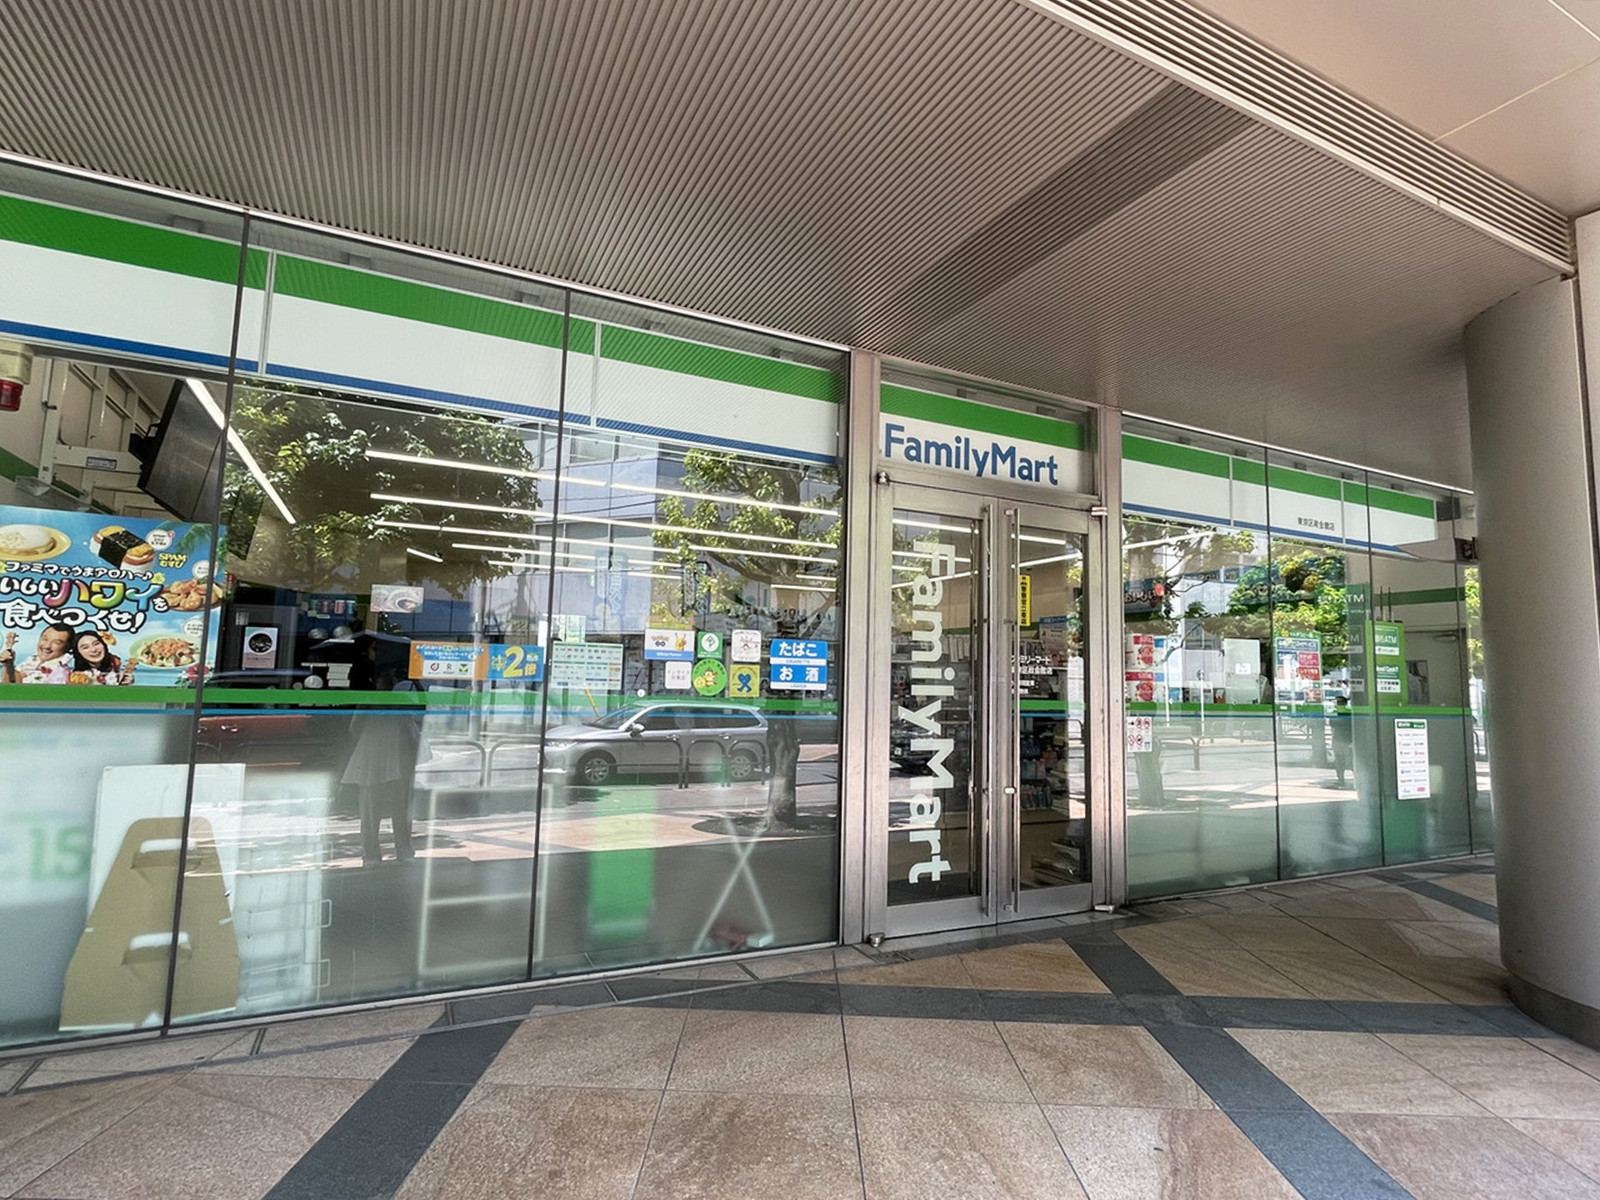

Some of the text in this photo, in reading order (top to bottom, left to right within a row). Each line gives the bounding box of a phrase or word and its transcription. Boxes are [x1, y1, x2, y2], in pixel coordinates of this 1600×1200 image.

[885, 423, 1058, 486] FamilyMart
[158, 553, 187, 563] SPAM
[779, 641, 817, 657] たばこ
[898, 541, 956, 884] FamilyMart
